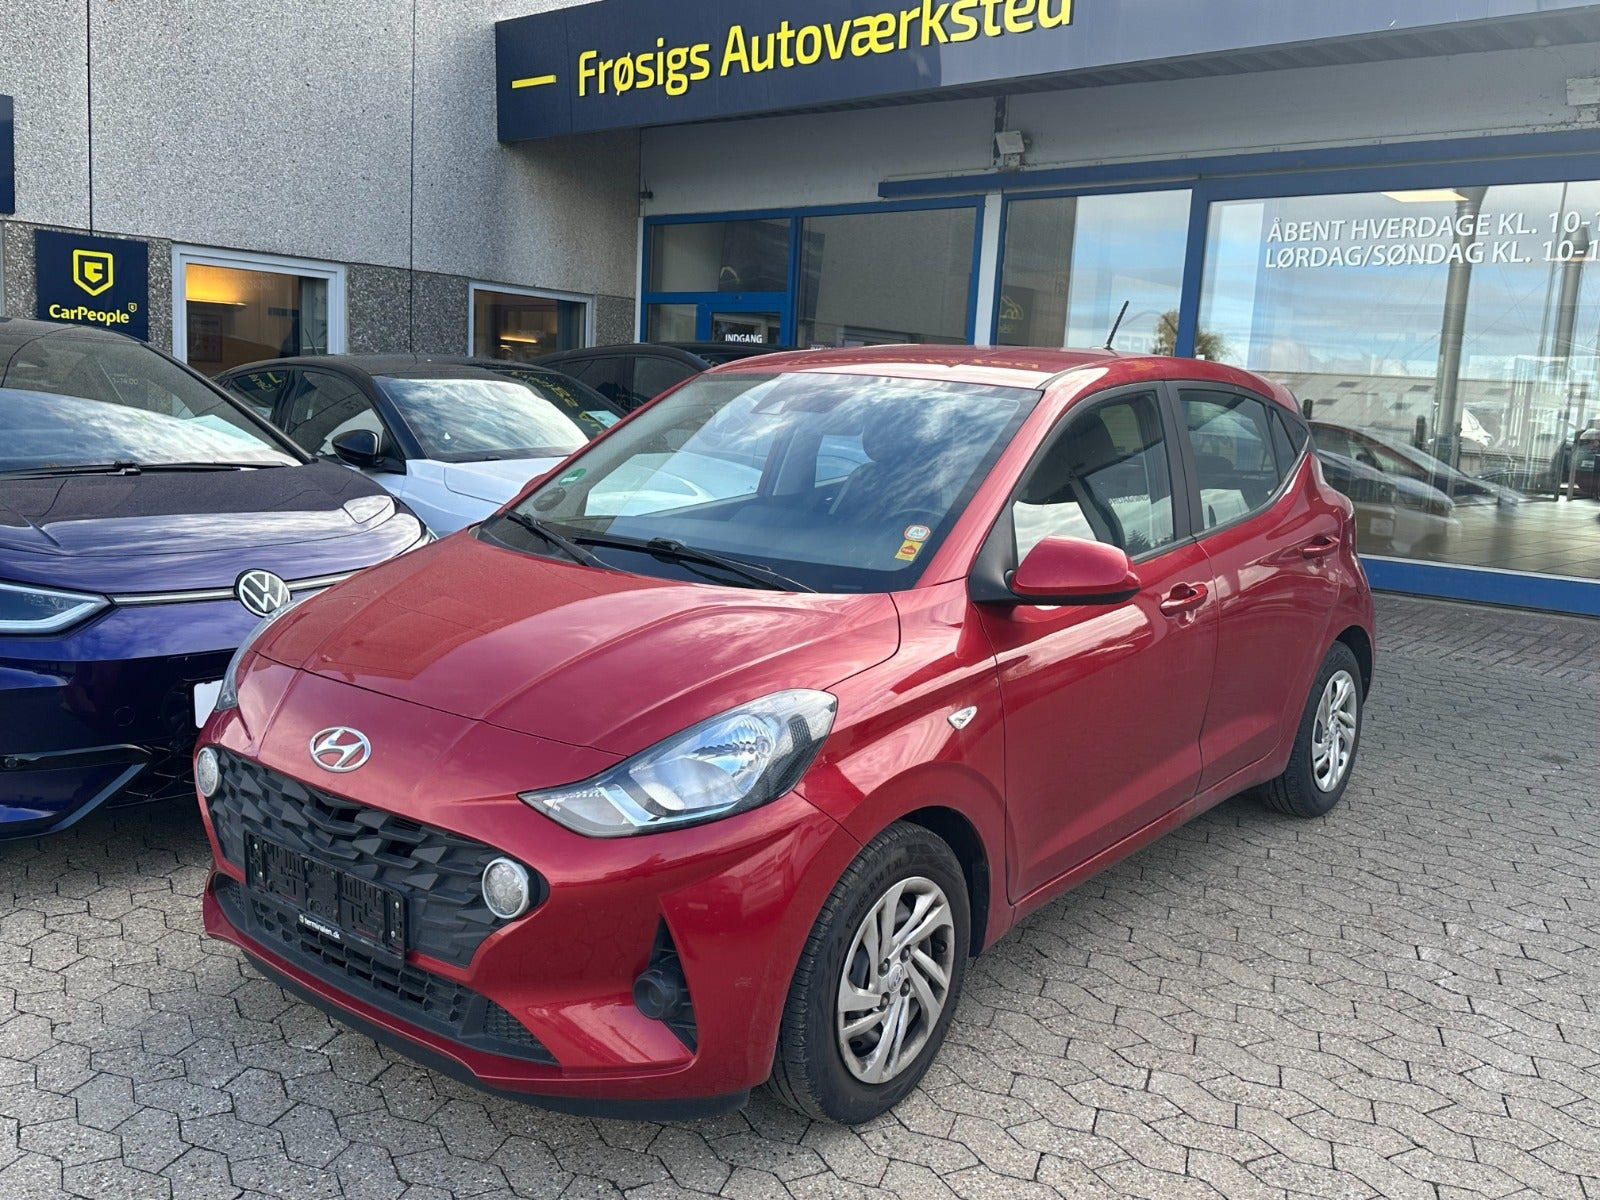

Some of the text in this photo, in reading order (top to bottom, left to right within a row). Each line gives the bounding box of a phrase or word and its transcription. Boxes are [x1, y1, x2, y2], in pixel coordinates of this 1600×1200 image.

[578, 38, 711, 96] Frøsigs
[1267, 216, 1346, 242] ÅBENT
[1351, 214, 1491, 240] HVERDAGE
[1498, 213, 1537, 236] KL.
[1265, 243, 1486, 268] LØRDAG/SØNDAG
[1492, 241, 1531, 263] KL.
[49, 304, 130, 327] CarPeople
[725, 333, 762, 344] INDGANG
